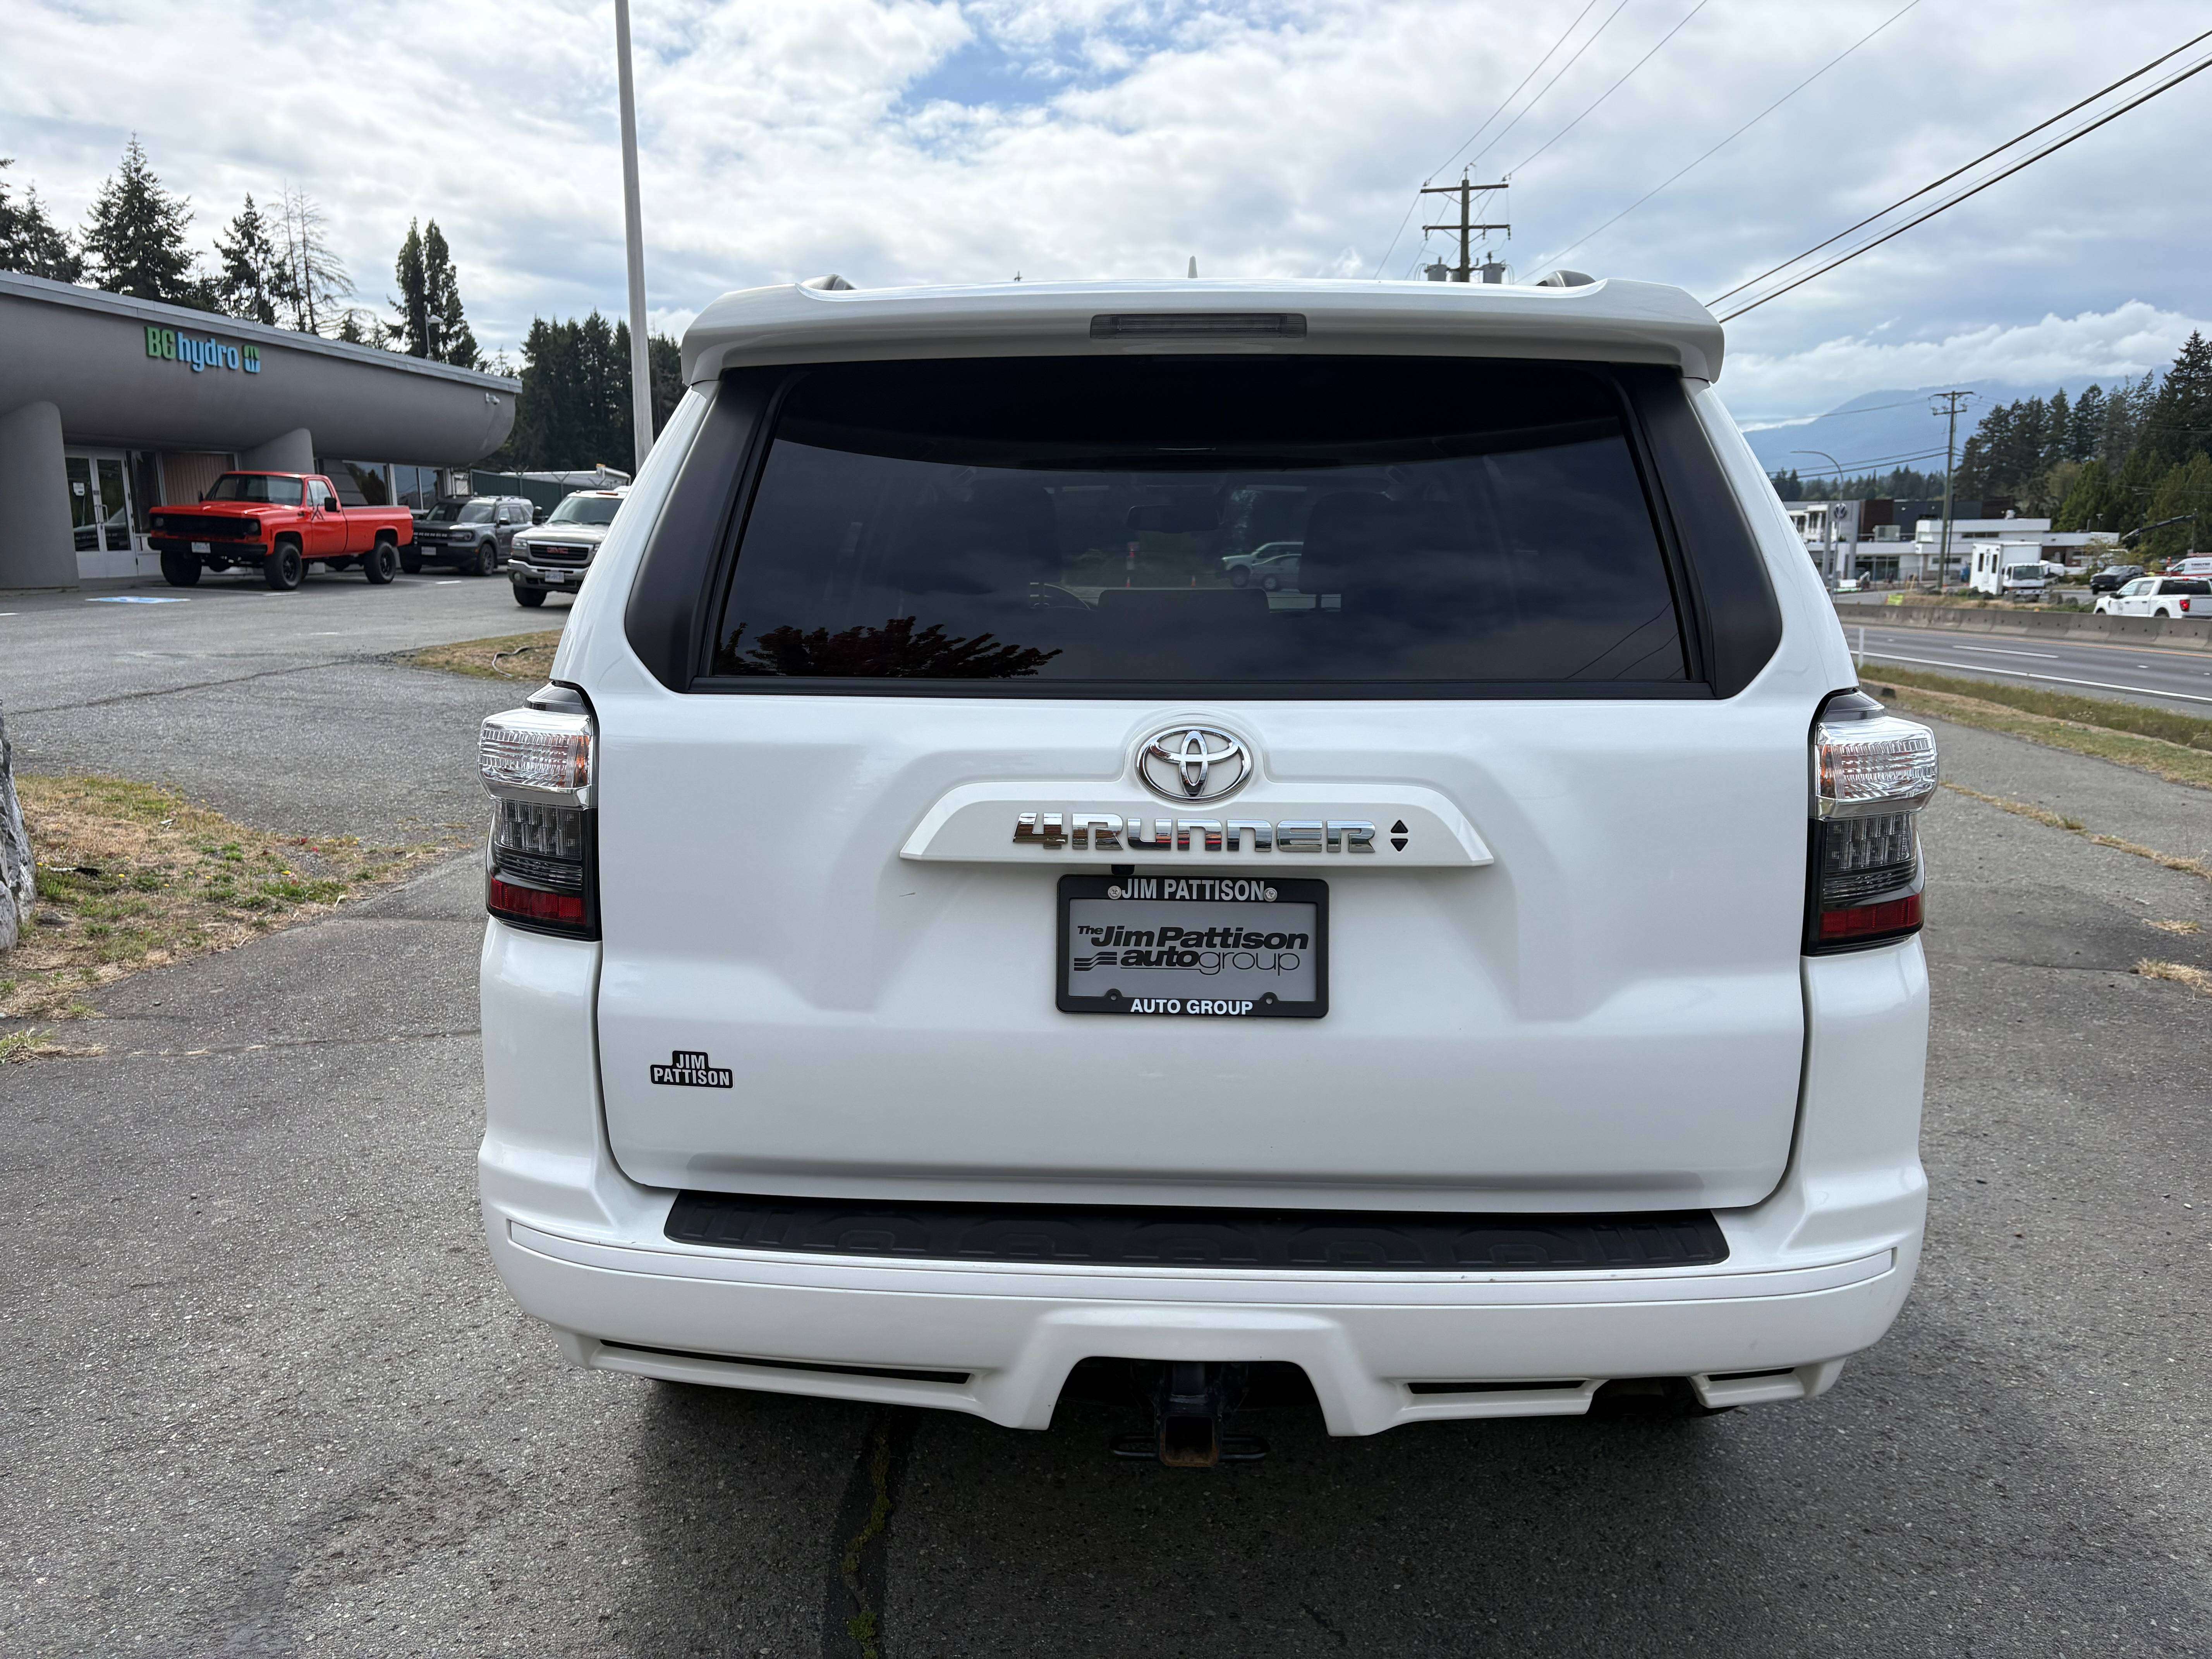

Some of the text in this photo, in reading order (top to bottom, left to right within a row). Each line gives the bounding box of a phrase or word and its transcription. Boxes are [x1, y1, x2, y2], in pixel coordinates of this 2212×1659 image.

[1122, 879, 1264, 901] JIM PATTISON
[1078, 926, 1309, 949] The Jim Pattison
[1130, 999, 1253, 1015] AUTO GROUP
[676, 1054, 705, 1069] JIM
[654, 1068, 729, 1085] PATTISON
